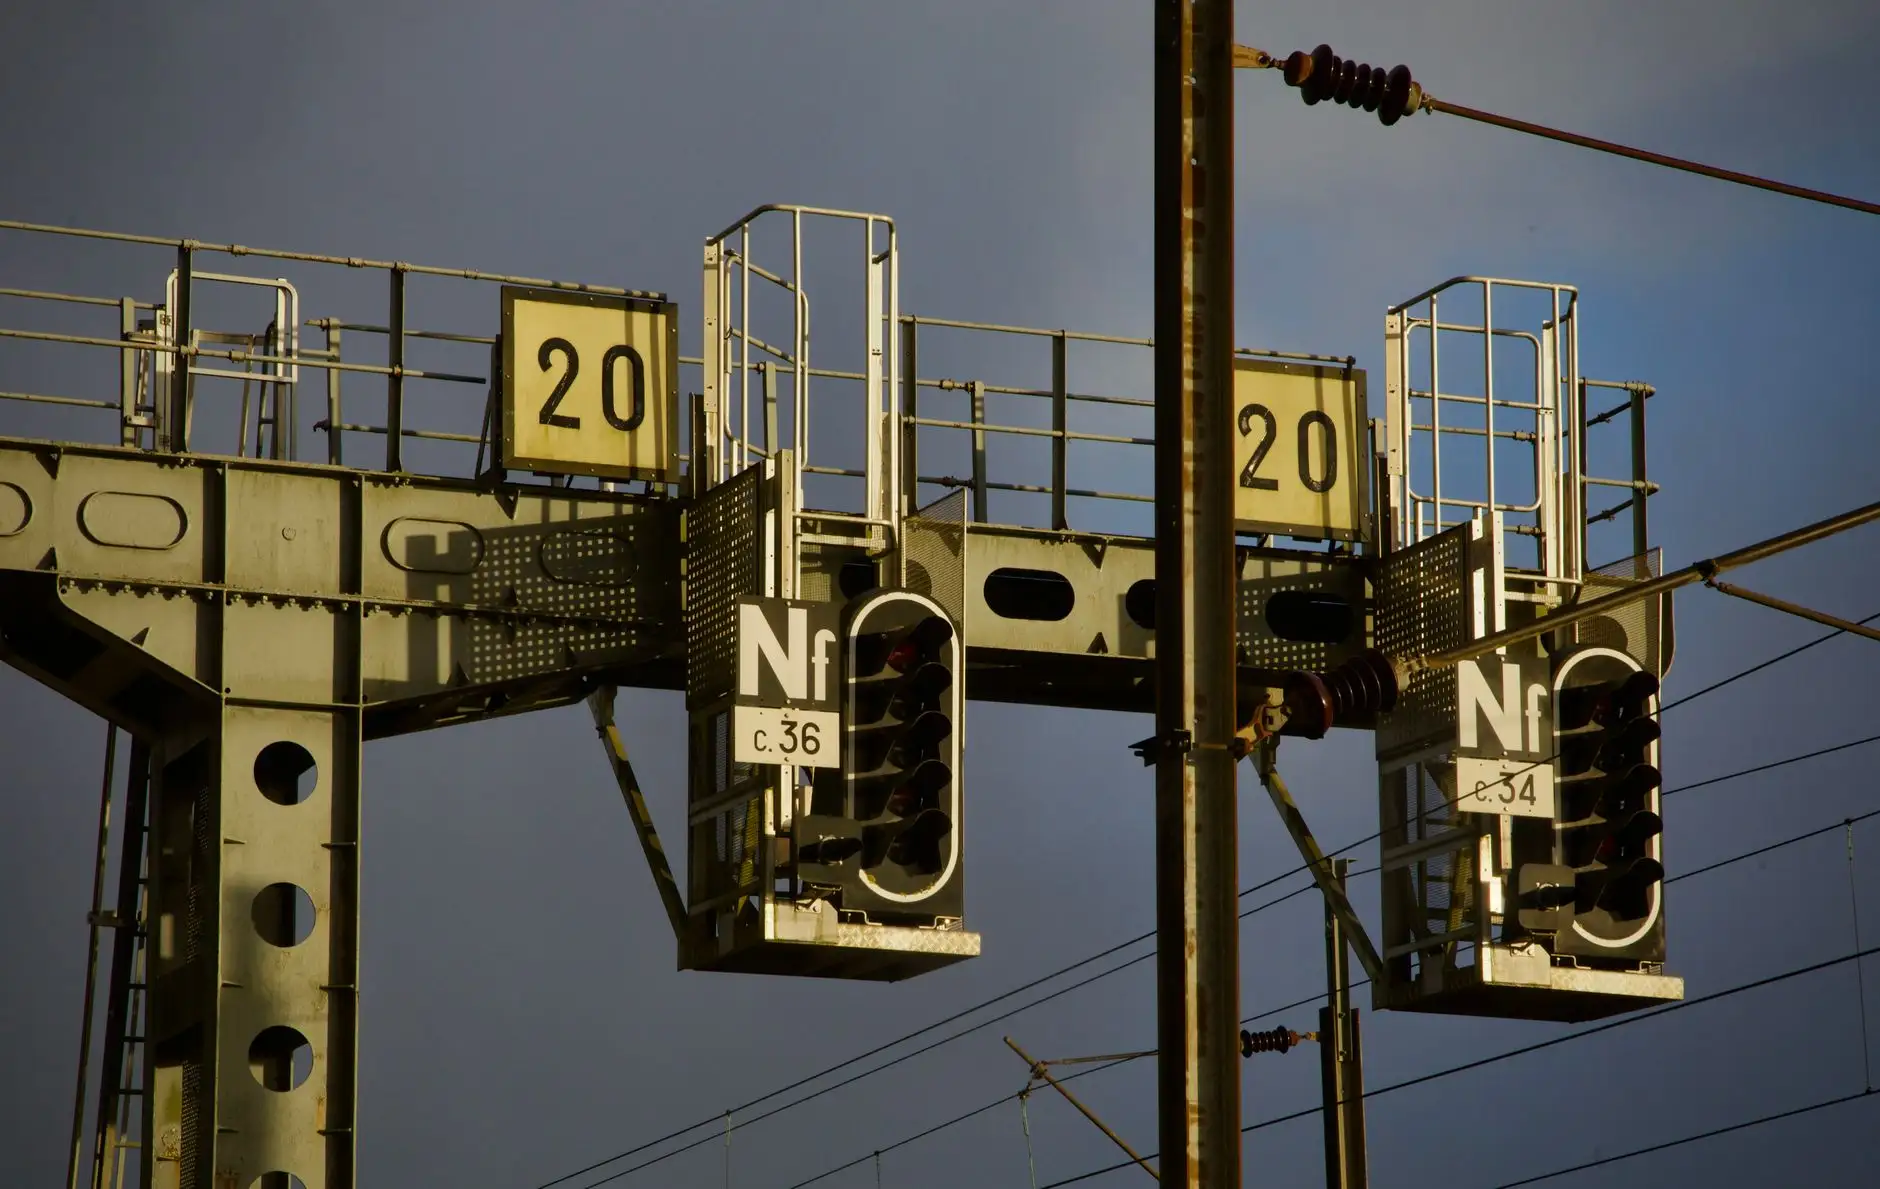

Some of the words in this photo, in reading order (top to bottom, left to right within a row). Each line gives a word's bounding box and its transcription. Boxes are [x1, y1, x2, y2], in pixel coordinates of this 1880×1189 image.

[538, 337, 645, 432] 20
[1238, 403, 1338, 493] 20
[740, 603, 837, 701] Nf
[1458, 660, 1548, 753] Nf
